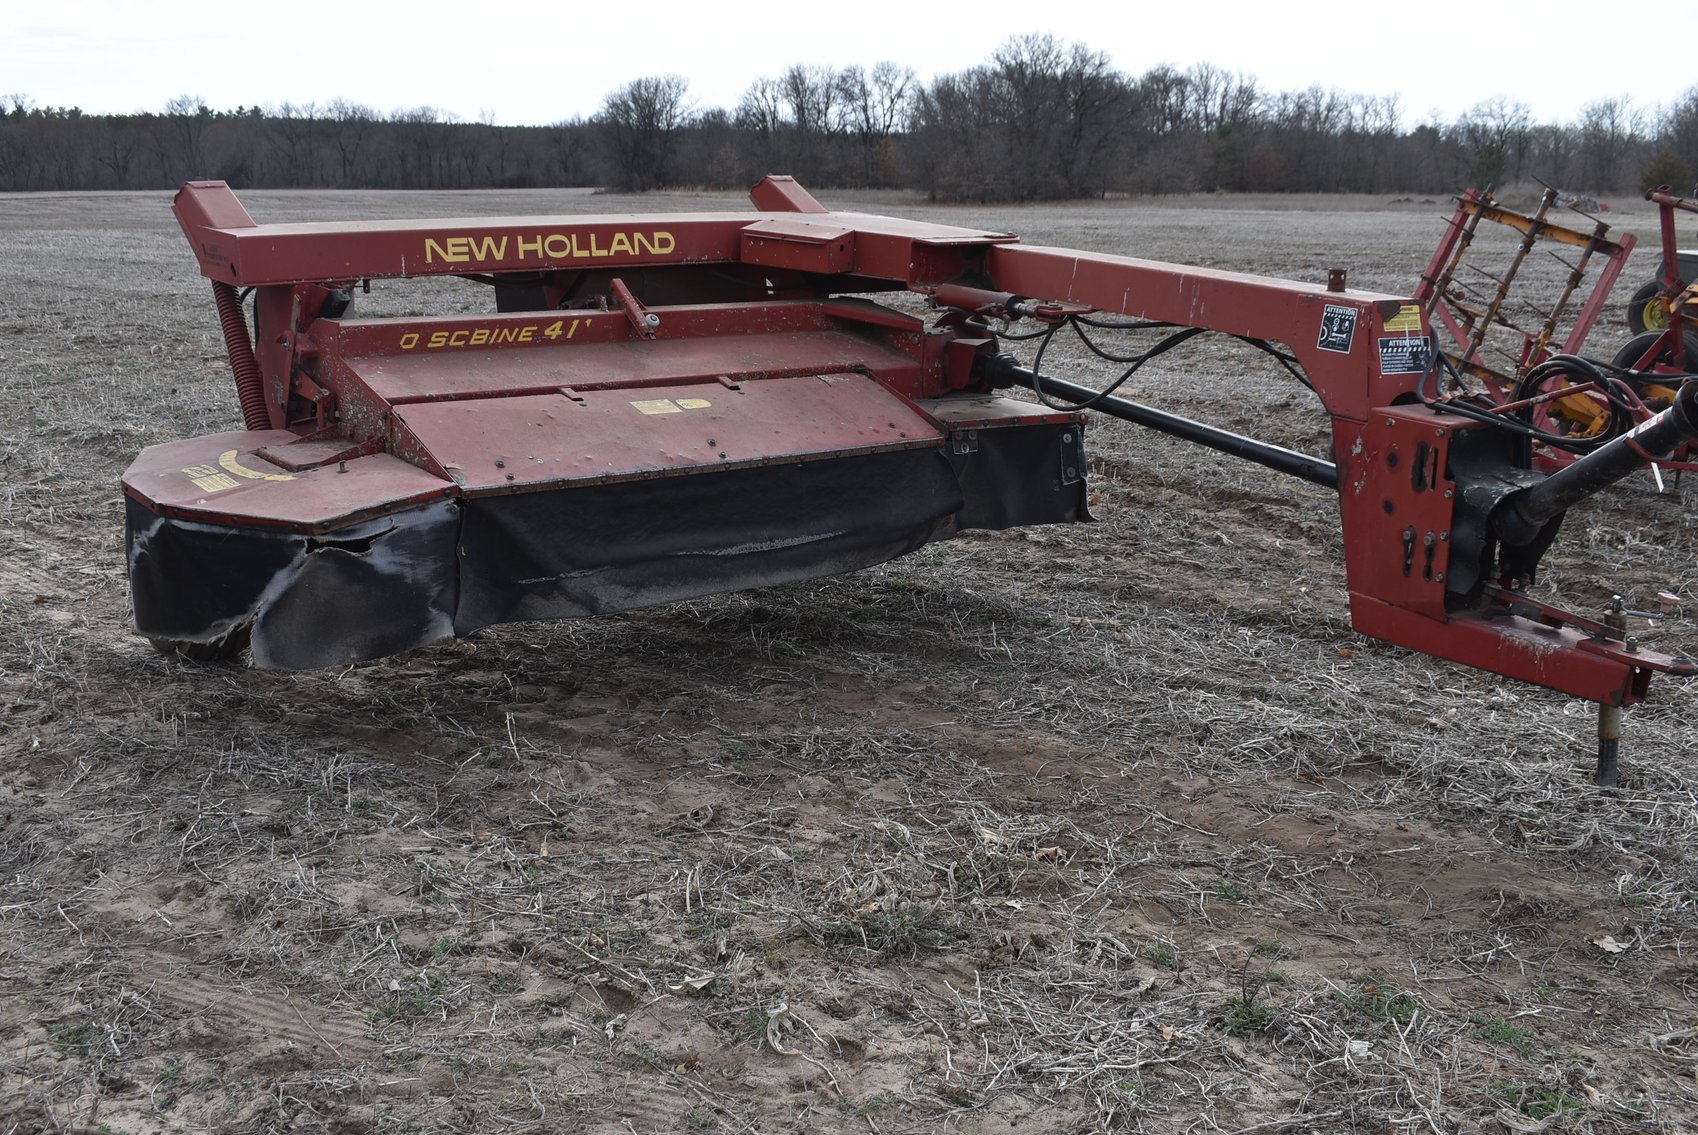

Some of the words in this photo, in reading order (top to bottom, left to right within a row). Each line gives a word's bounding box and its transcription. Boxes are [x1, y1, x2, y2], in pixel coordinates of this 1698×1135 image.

[425, 236, 508, 263] NEW
[517, 231, 676, 260] HOLLAND
[1326, 306, 1356, 317] ATTENTION
[1388, 339, 1421, 347] ATTENTION
